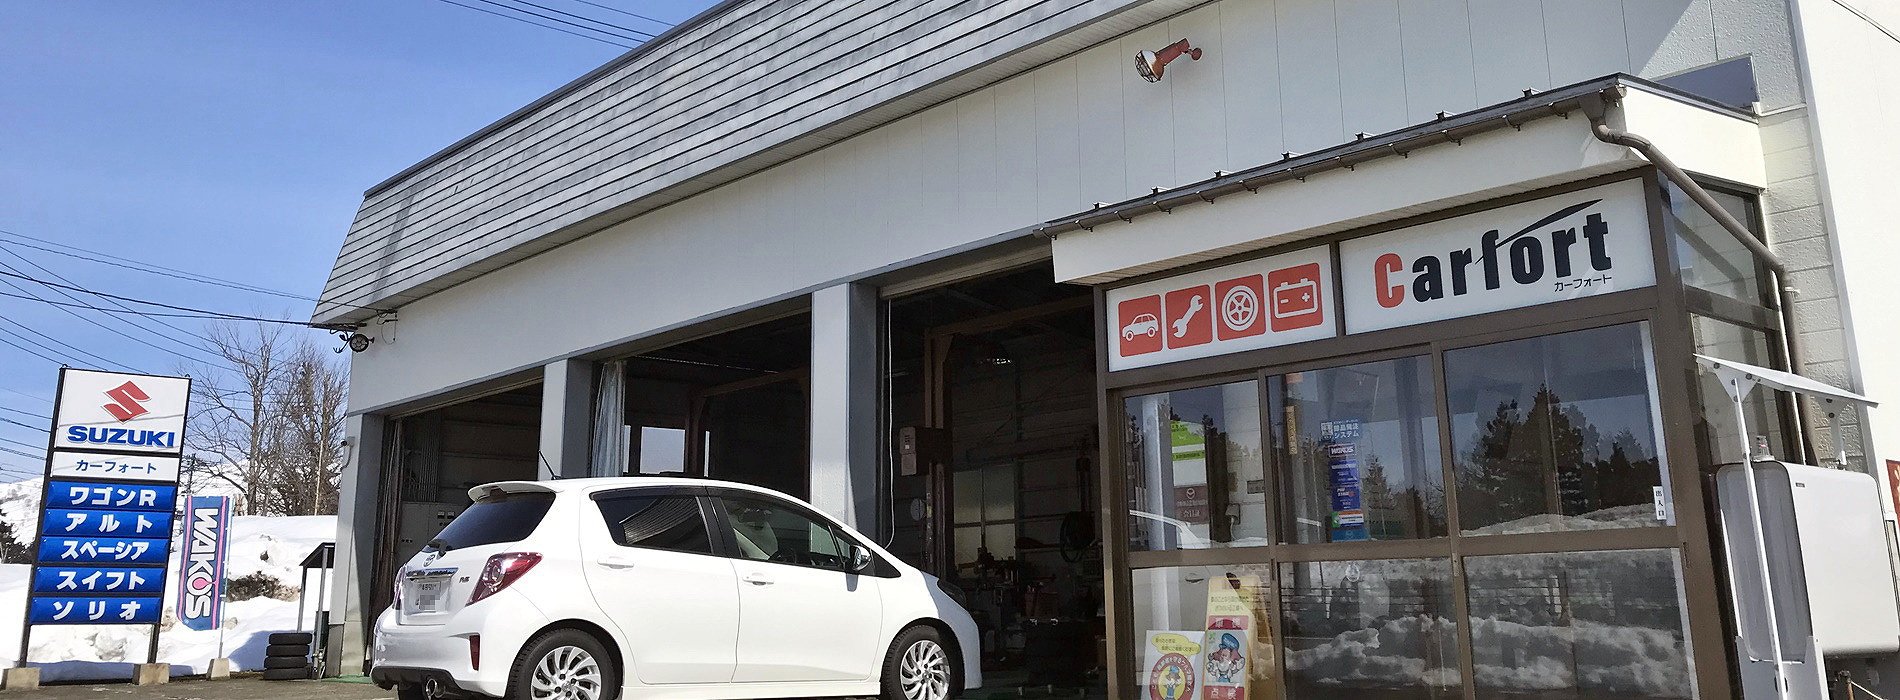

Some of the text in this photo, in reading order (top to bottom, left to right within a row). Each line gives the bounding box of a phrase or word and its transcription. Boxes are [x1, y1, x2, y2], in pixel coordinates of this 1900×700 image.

[1374, 211, 1612, 308] Carfort
[1554, 274, 1612, 293] カーフォート
[67, 425, 175, 448] SUZUKI
[75, 459, 157, 474] カーフォート
[69, 486, 157, 507] ワゴンR
[1655, 490, 1665, 516] 出入口
[65, 512, 153, 533] アルト
[61, 540, 150, 560] スペーシア
[56, 570, 146, 591] スイフト
[53, 600, 141, 621] ソリオ
